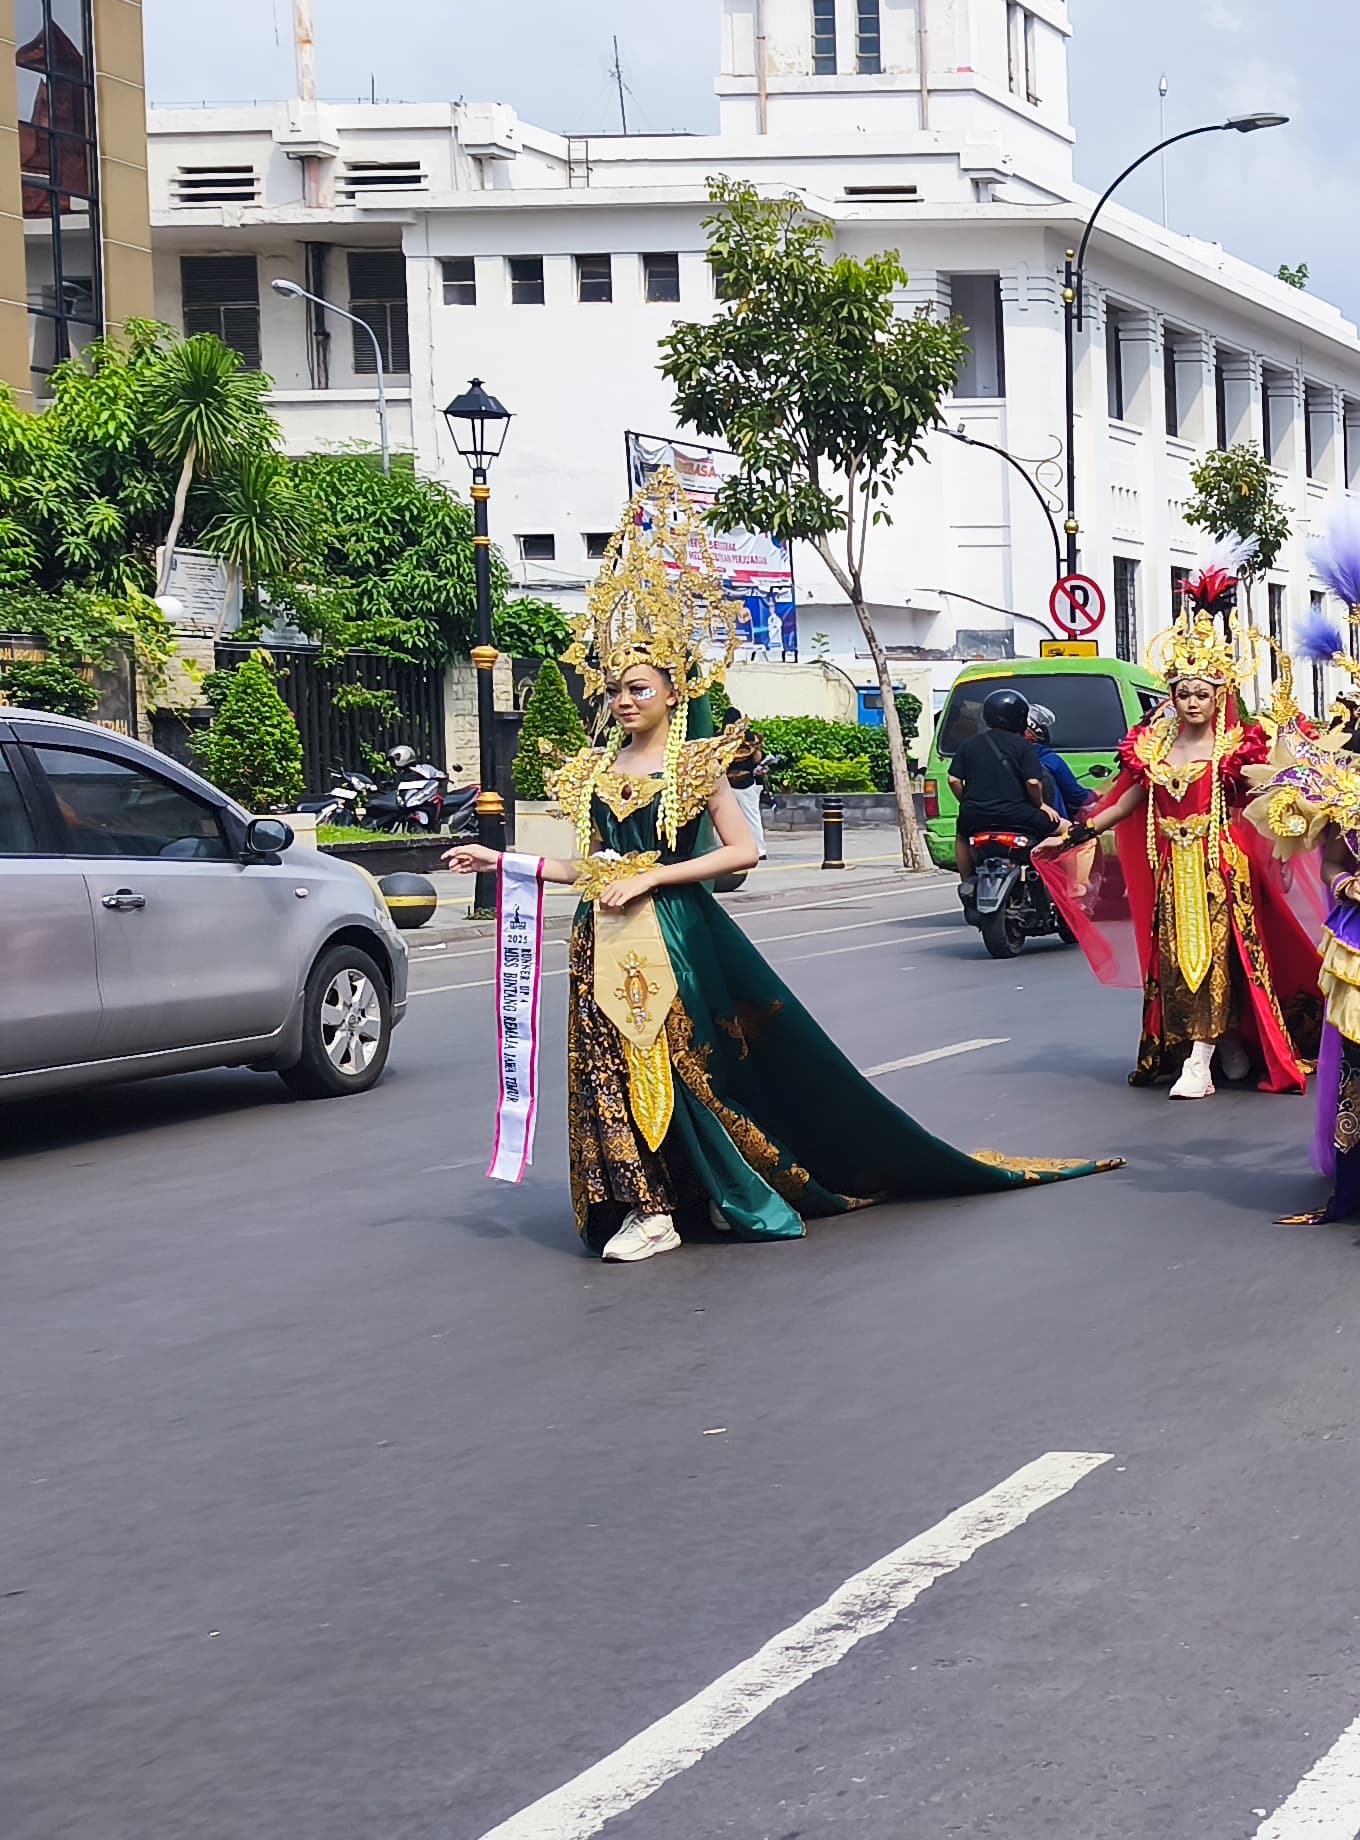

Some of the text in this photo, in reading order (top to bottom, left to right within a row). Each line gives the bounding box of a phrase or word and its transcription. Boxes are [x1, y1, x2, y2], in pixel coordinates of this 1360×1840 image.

[1069, 585, 1089, 623] P
[507, 934, 528, 944] 2025
[504, 947, 519, 968] MISS
[519, 948, 532, 981] RUNNER
[503, 972, 518, 1012] BINTANG
[519, 985, 530, 996] UP
[503, 1015, 519, 1050] REMAJA
[504, 1053, 517, 1073] JAWA
[505, 1077, 520, 1103] TIMUR
